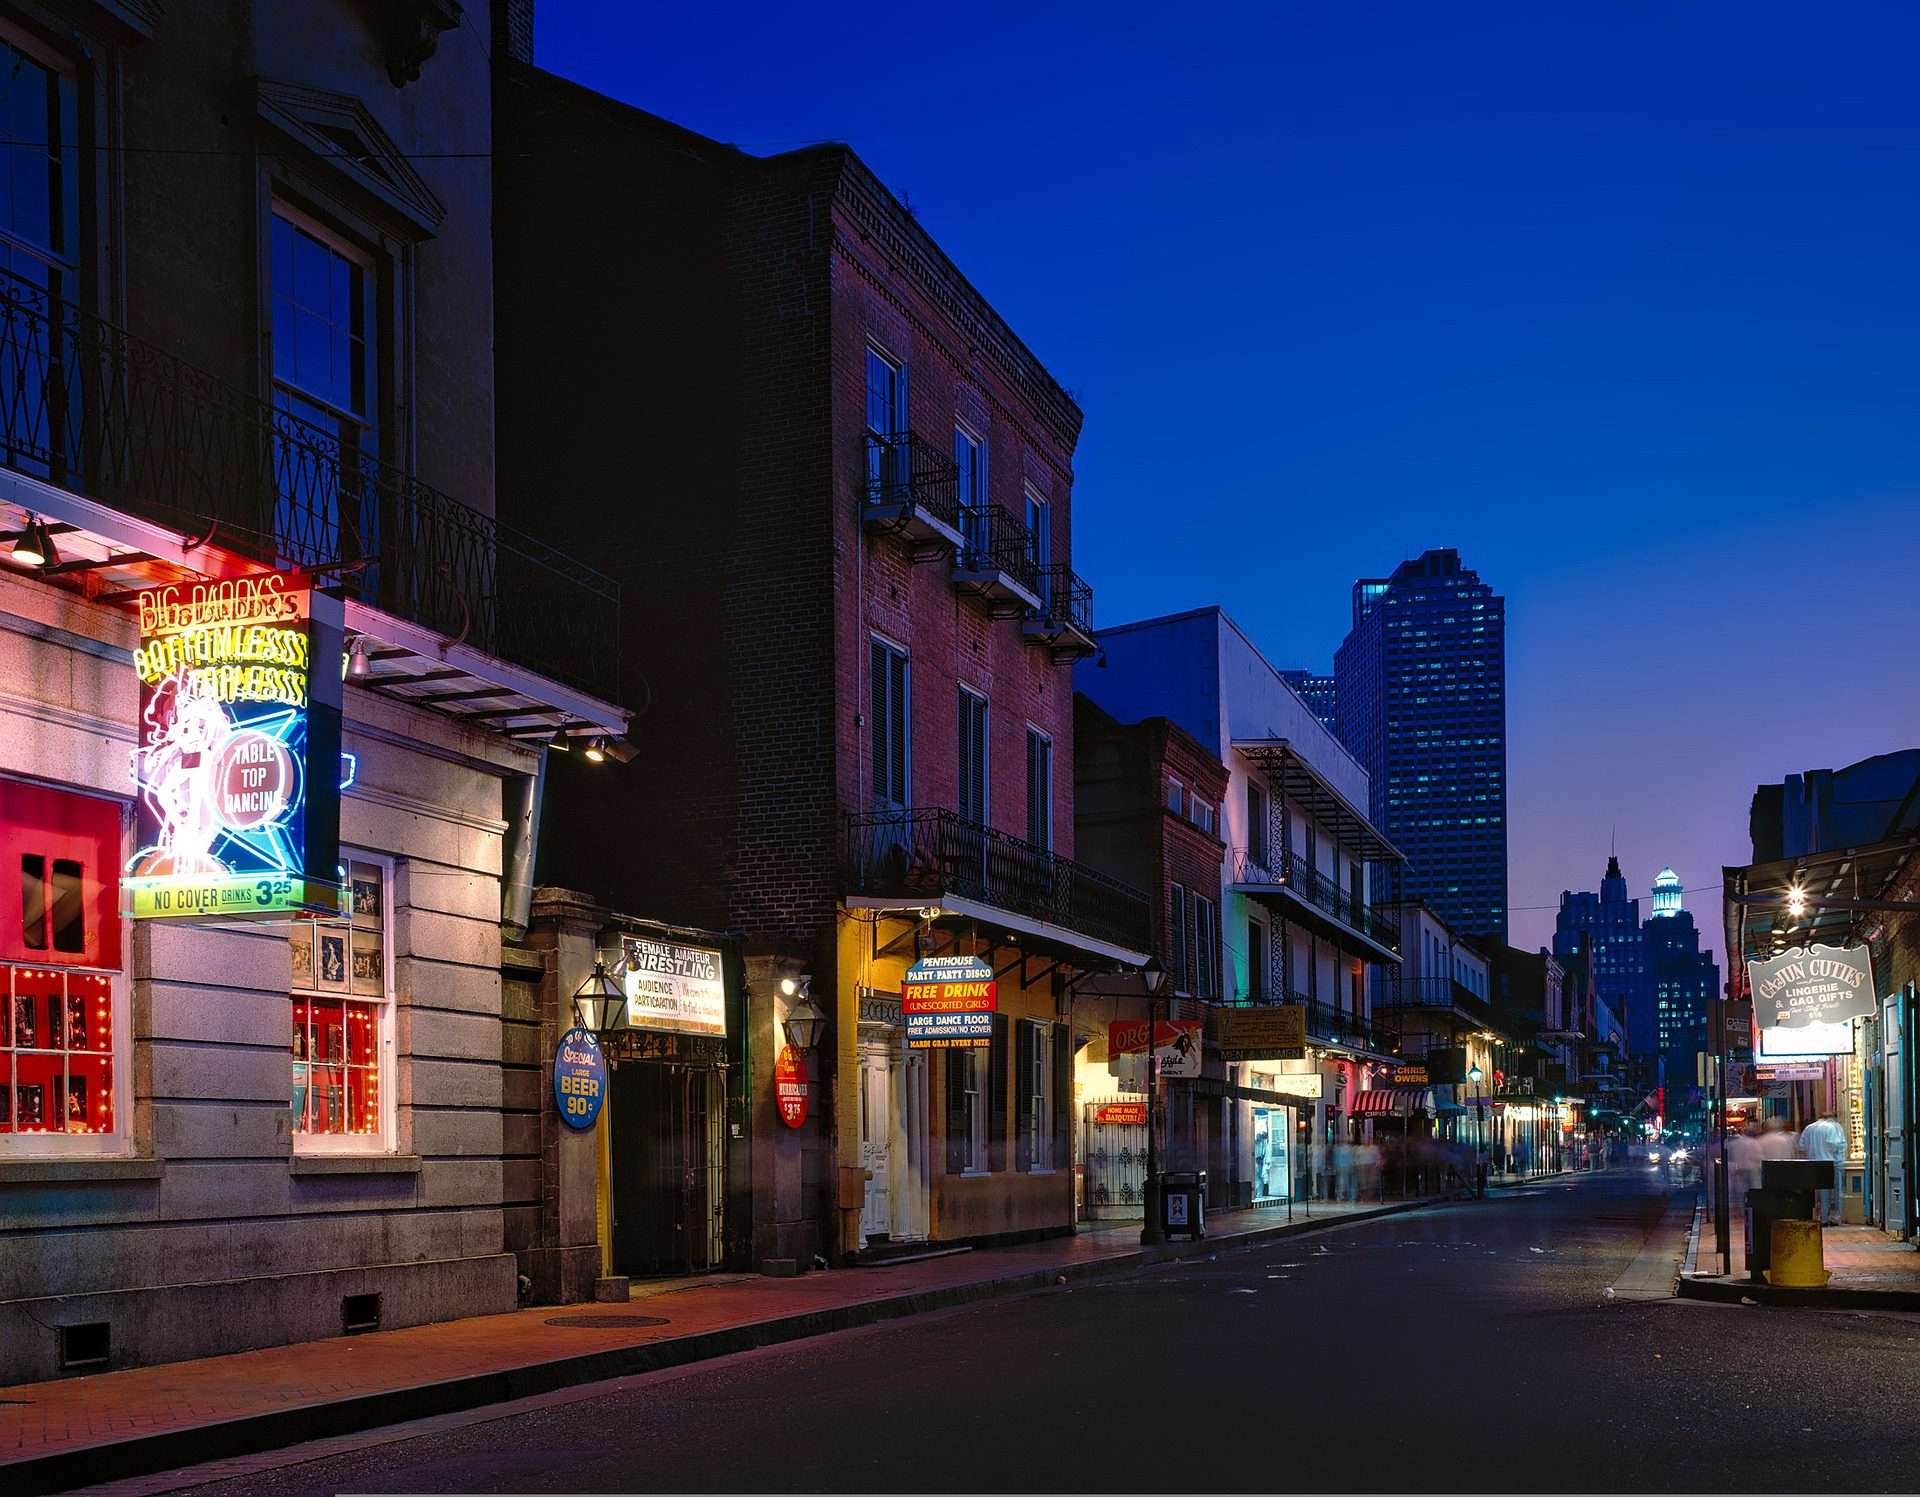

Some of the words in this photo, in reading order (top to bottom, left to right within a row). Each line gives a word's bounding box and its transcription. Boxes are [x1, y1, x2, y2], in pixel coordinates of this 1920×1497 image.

[139, 586, 182, 632] BIG
[233, 743, 275, 764] TABLE
[241, 768, 266, 788] TOP
[154, 890, 171, 909] NO
[177, 888, 218, 908] COVER
[221, 888, 252, 903] DRINKS
[635, 941, 670, 957] FEMALE
[674, 948, 710, 964] AMATEUR
[923, 956, 974, 967] PENTHOUSE
[1759, 962, 1806, 999] CAJUN
[1810, 959, 1865, 988] CUTIES
[638, 980, 673, 995] AUDIENCE
[906, 985, 937, 999] FREE
[943, 983, 989, 998] DRINK
[1786, 983, 1839, 998] LINGERIE
[910, 1001, 963, 1011] (UNESCORTED
[965, 1000, 990, 1010] GIRLS)
[1775, 1000, 1783, 1008] &
[1790, 993, 1814, 1007] GAG
[1818, 990, 1853, 1003] GIFTS
[909, 1017, 934, 1026] LARGE
[936, 1016, 961, 1025] DANCE
[964, 1015, 990, 1024] FLOOR
[907, 1027, 922, 1035] FREE
[970, 1025, 992, 1033] COVER
[910, 1040, 931, 1048] MARDI
[932, 1040, 949, 1048] GRAS
[951, 1039, 972, 1047] EVERY
[973, 1039, 990, 1047] NITE
[571, 1069, 591, 1077] LARGE
[1397, 1066, 1425, 1075] CHRIS
[561, 1076, 599, 1096] BEER
[1394, 1074, 1429, 1083] OWENS
